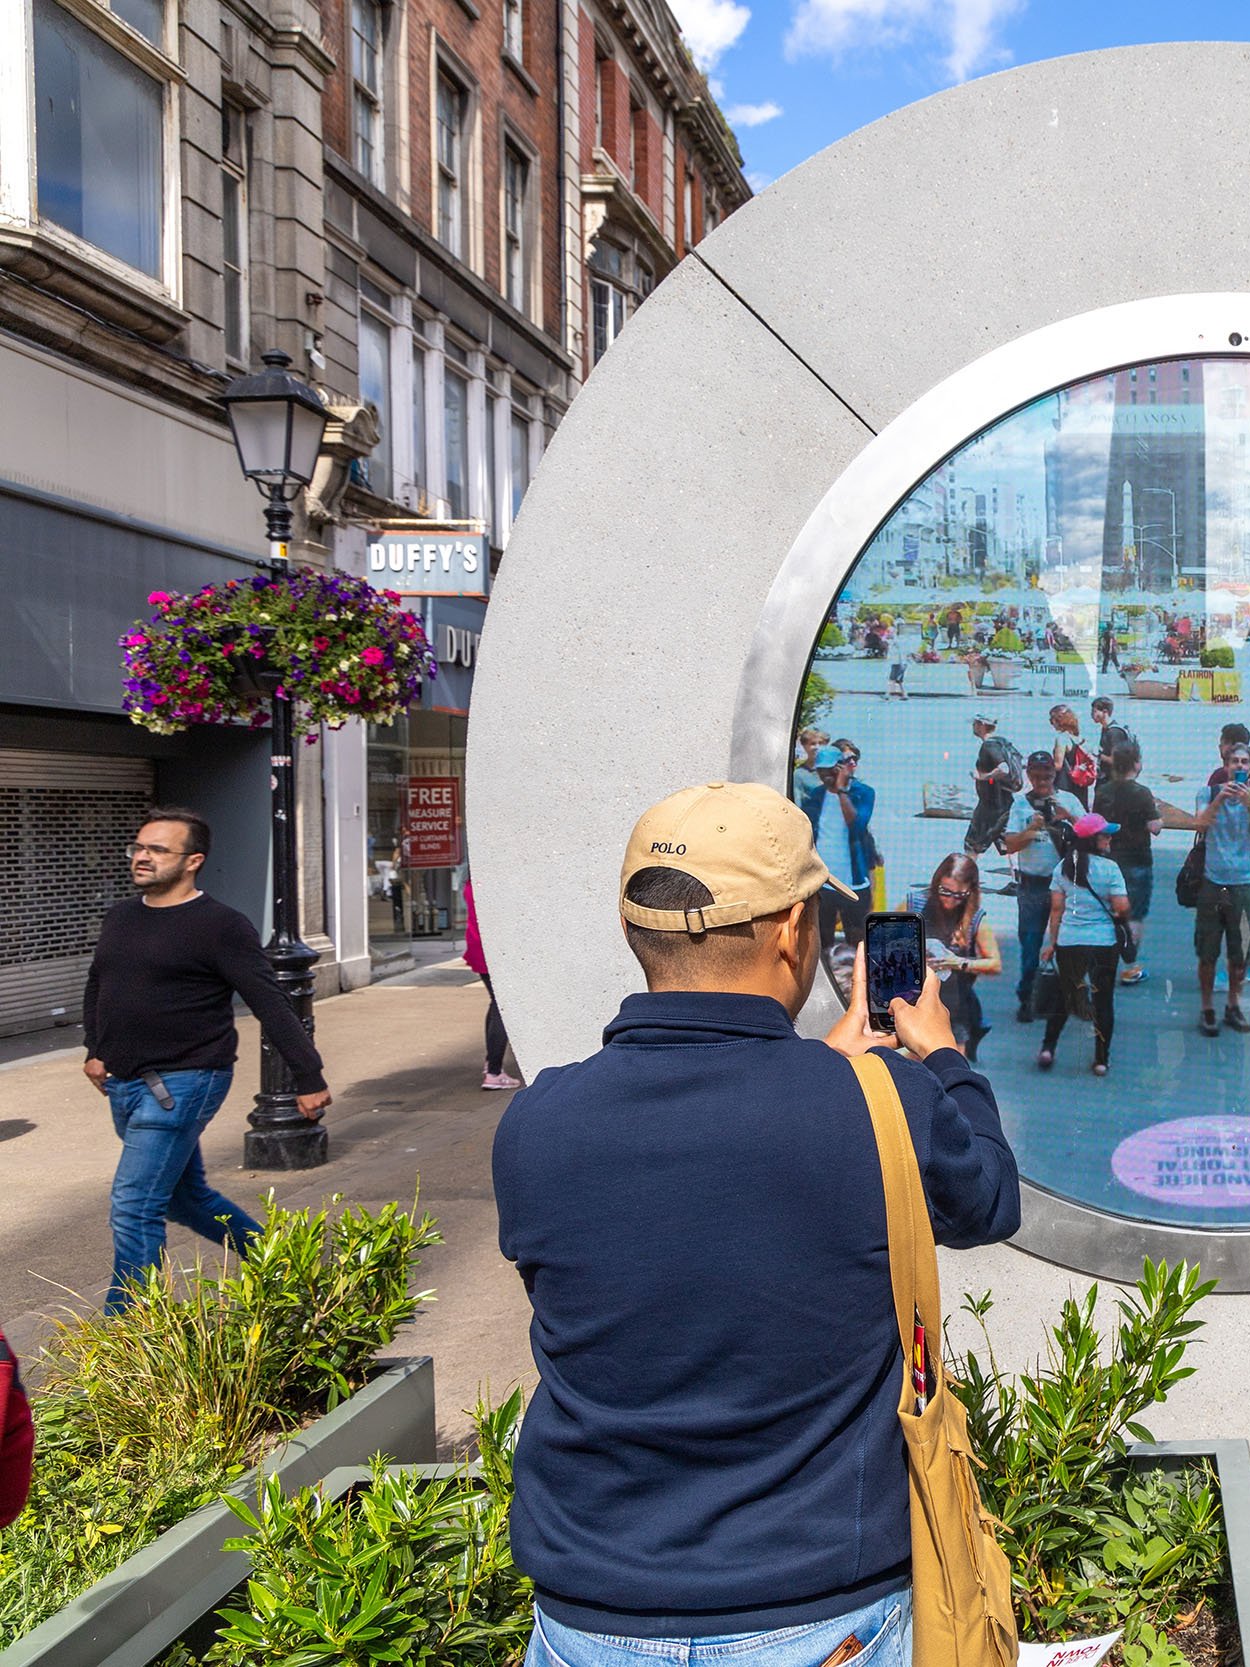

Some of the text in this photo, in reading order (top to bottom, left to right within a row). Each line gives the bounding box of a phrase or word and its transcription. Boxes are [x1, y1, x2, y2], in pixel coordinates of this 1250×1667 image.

[370, 541, 478, 573] DUFFY'S
[1031, 665, 1066, 674] FLATIRON
[1178, 669, 1214, 679] FLATIRON
[1212, 694, 1240, 703] NOMAD
[408, 787, 453, 805] FREE
[408, 807, 452, 818] MEASURE
[410, 820, 450, 832] SERVICE
[650, 842, 687, 856] POLO
[1153, 1160, 1237, 1172] PORTAL
[1152, 1173, 1208, 1186] HERE
[1053, 1644, 1101, 1660] TOWN
